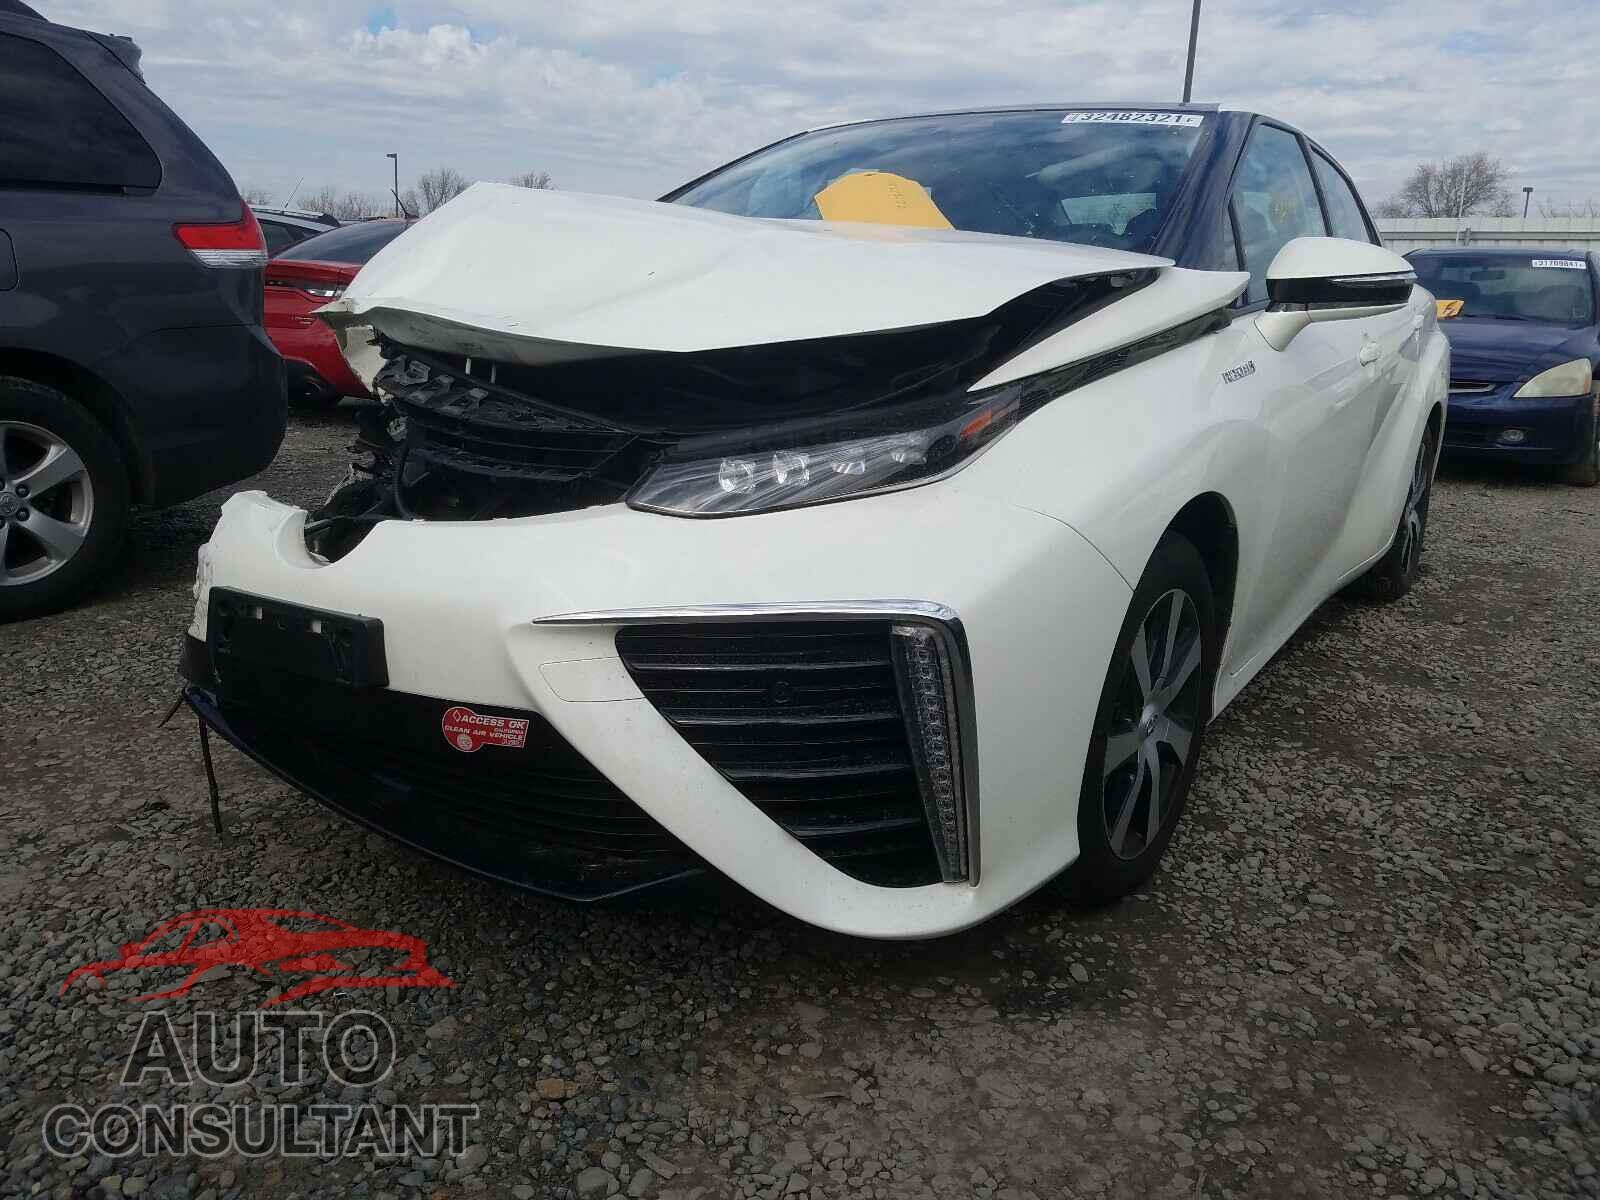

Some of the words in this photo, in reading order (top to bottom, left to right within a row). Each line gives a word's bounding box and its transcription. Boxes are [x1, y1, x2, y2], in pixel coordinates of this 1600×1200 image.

[461, 715, 505, 727] ACCESS
[508, 720, 526, 730] OK
[444, 725, 471, 734] CLEAN
[472, 729, 487, 737] AIR
[489, 732, 523, 741] VEHICLE
